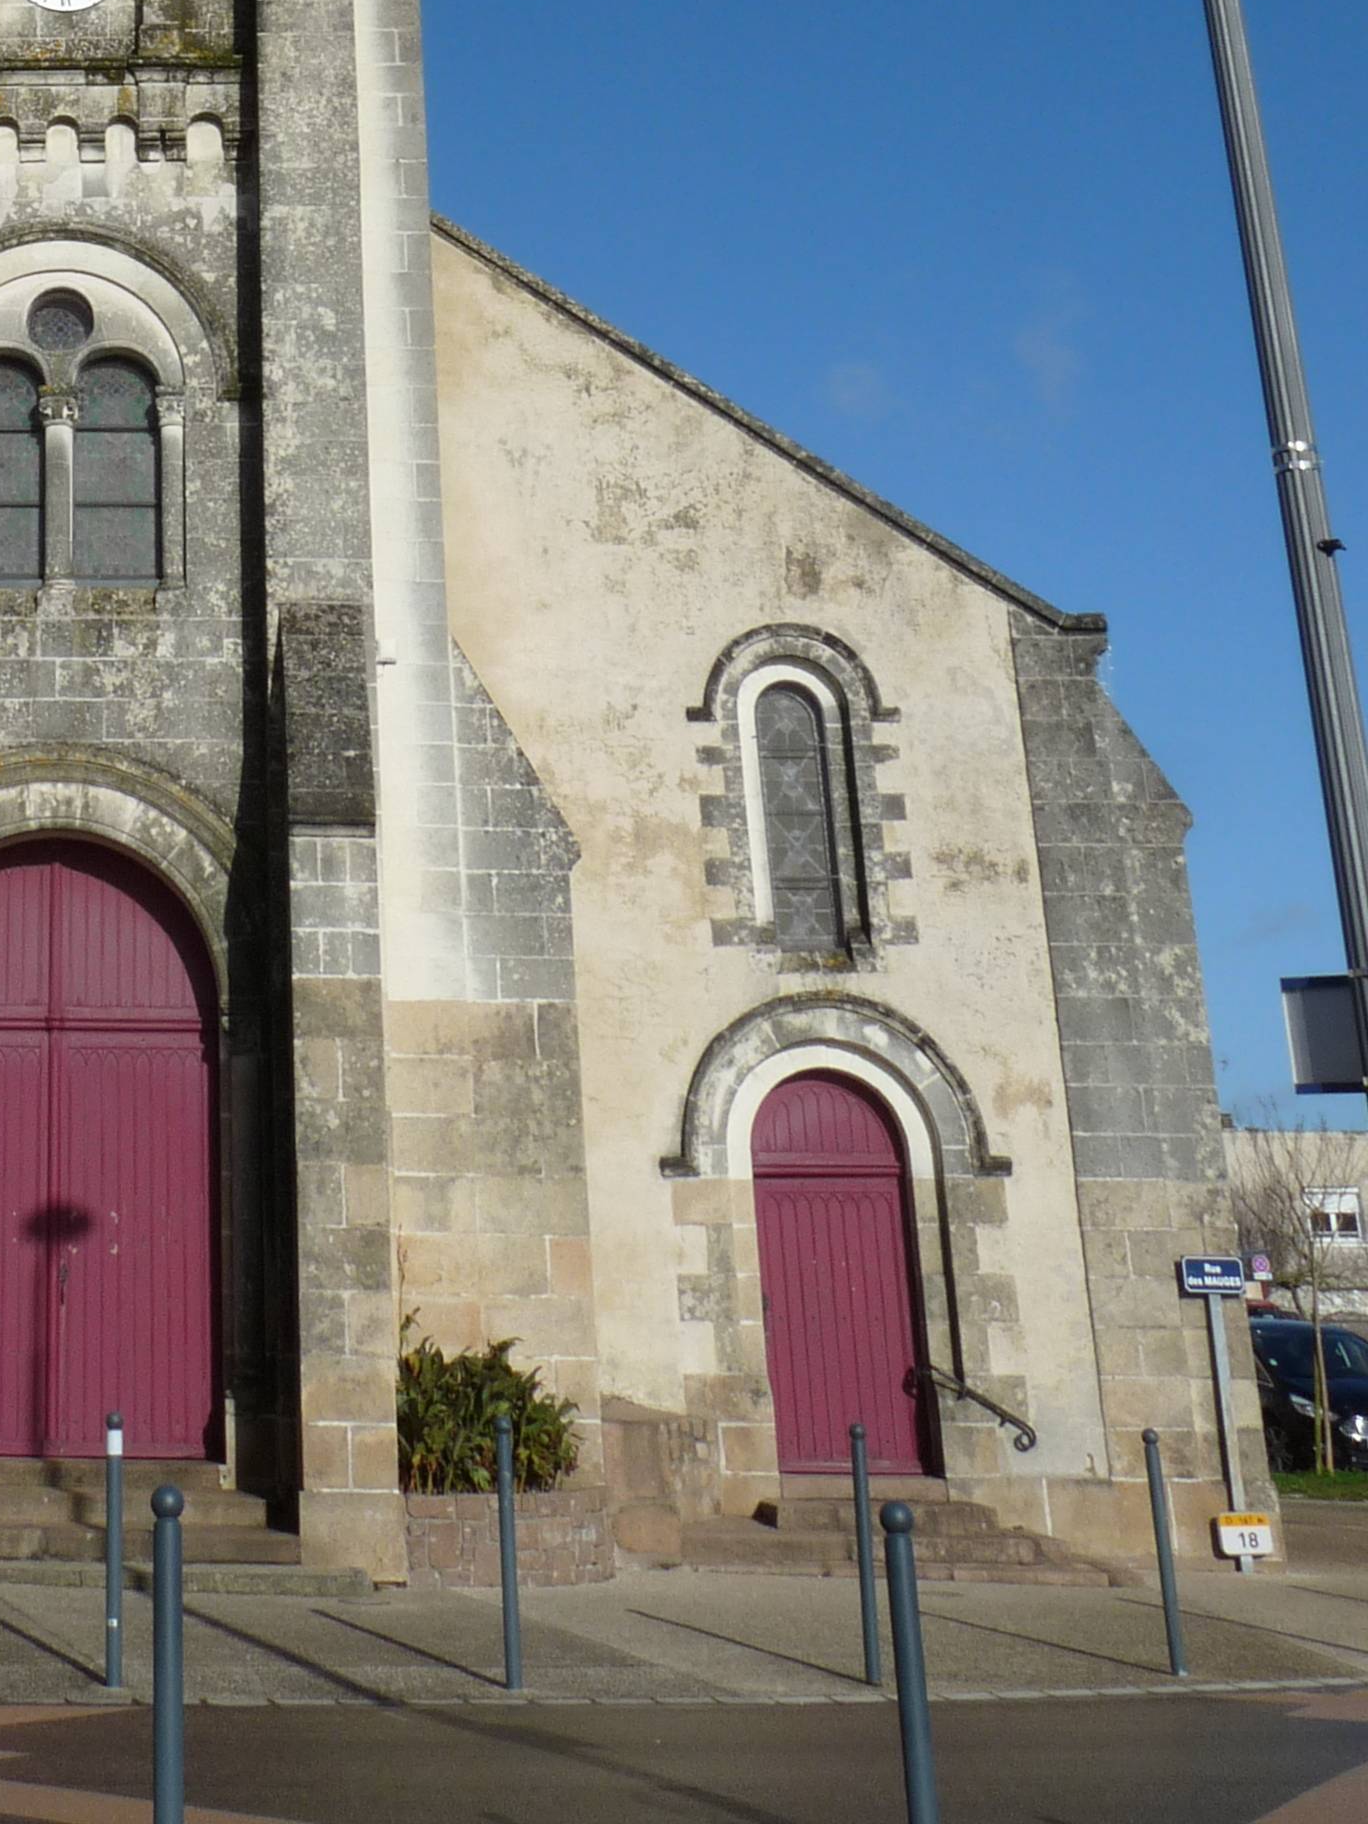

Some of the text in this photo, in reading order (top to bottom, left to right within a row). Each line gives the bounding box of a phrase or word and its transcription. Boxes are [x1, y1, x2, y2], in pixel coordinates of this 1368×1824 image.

[1204, 1263, 1221, 1274] Rue
[1188, 1276, 1241, 1286] des MAUGES
[1239, 1532, 1259, 1548] 18
